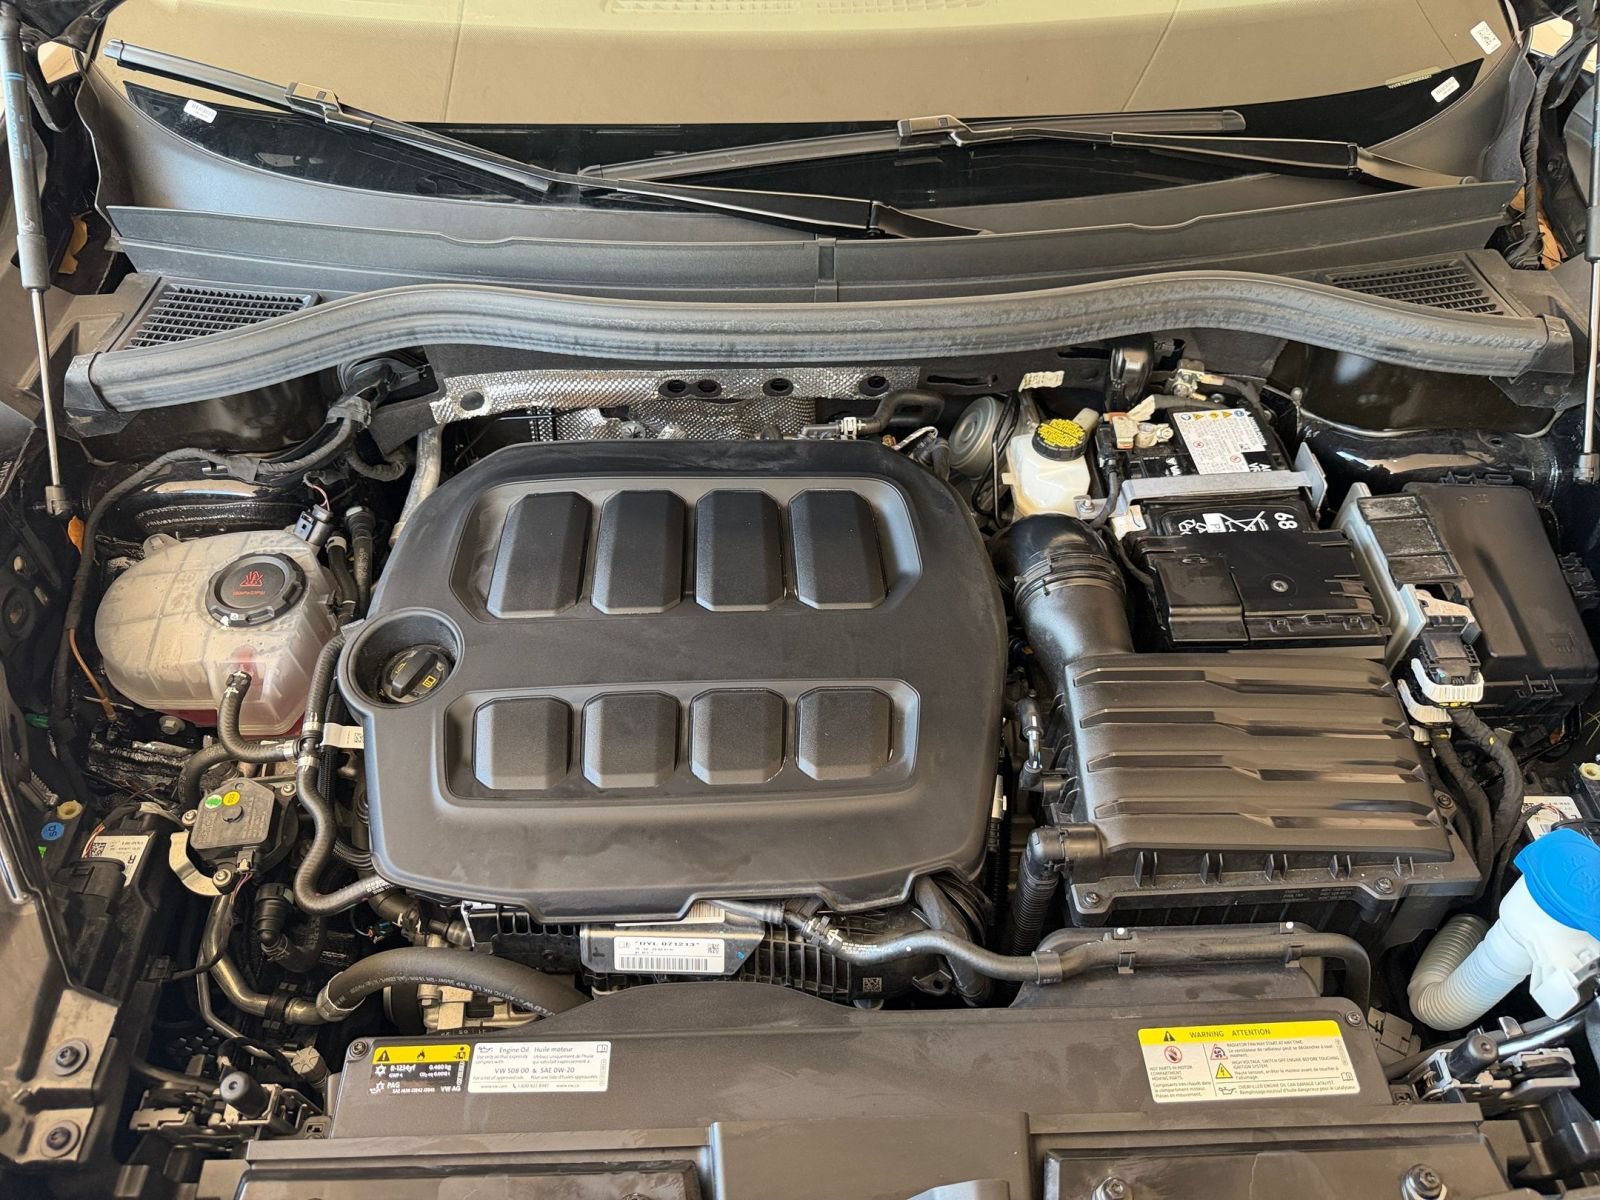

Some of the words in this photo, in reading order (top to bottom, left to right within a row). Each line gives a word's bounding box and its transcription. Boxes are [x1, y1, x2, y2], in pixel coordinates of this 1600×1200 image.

[1274, 512, 1298, 530] 68
[1189, 1030, 1224, 1038] WARNING
[1232, 1028, 1270, 1036] ATTENTION
